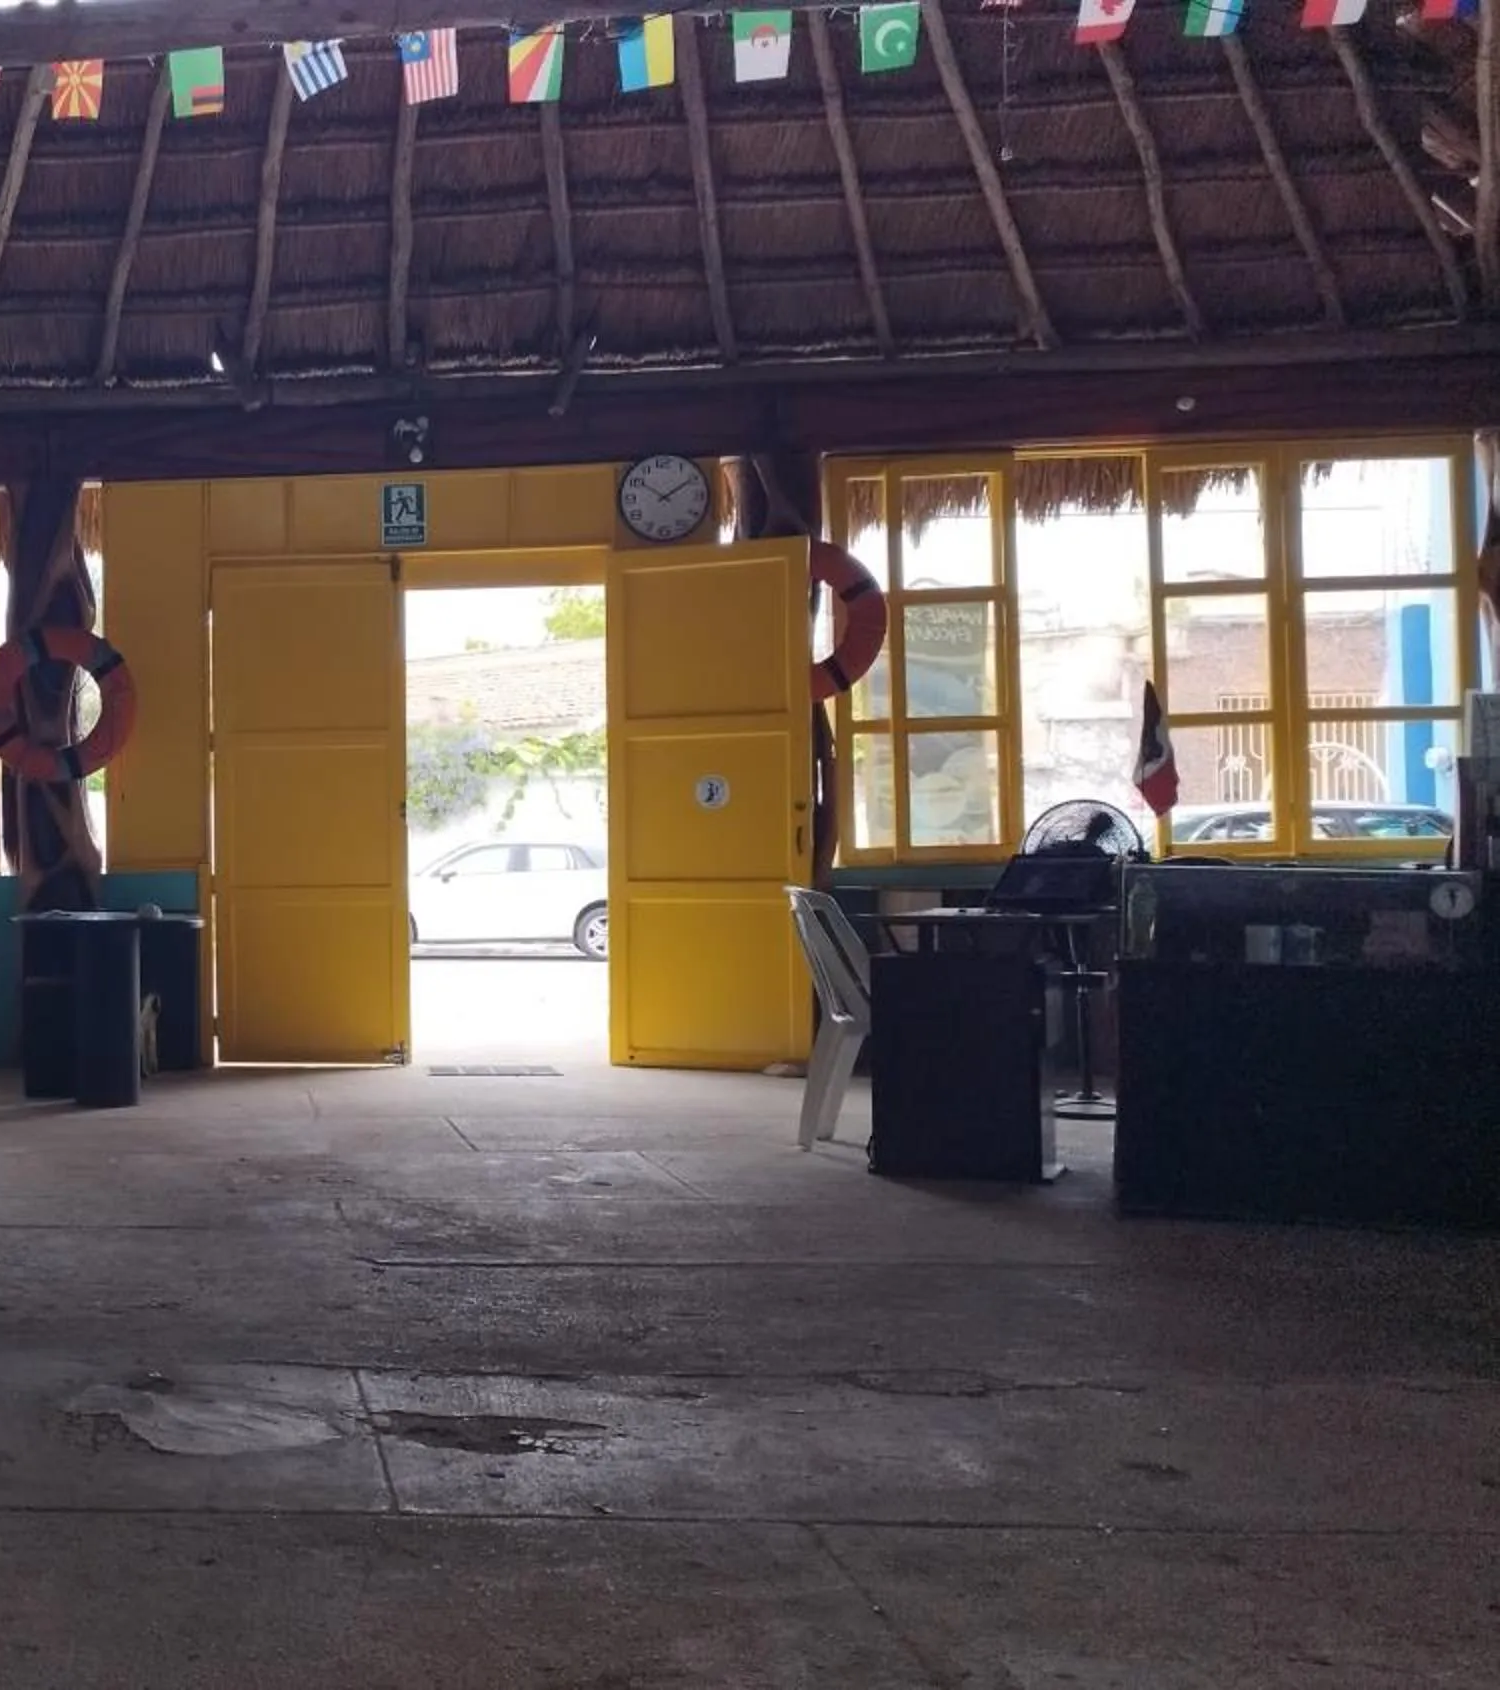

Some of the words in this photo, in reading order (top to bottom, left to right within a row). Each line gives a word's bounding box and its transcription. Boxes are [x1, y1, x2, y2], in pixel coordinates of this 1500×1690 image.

[655, 457, 671, 469] 12
[625, 493, 637, 505] 9
[630, 509, 643, 521] 8
[658, 526, 672, 538] 6
